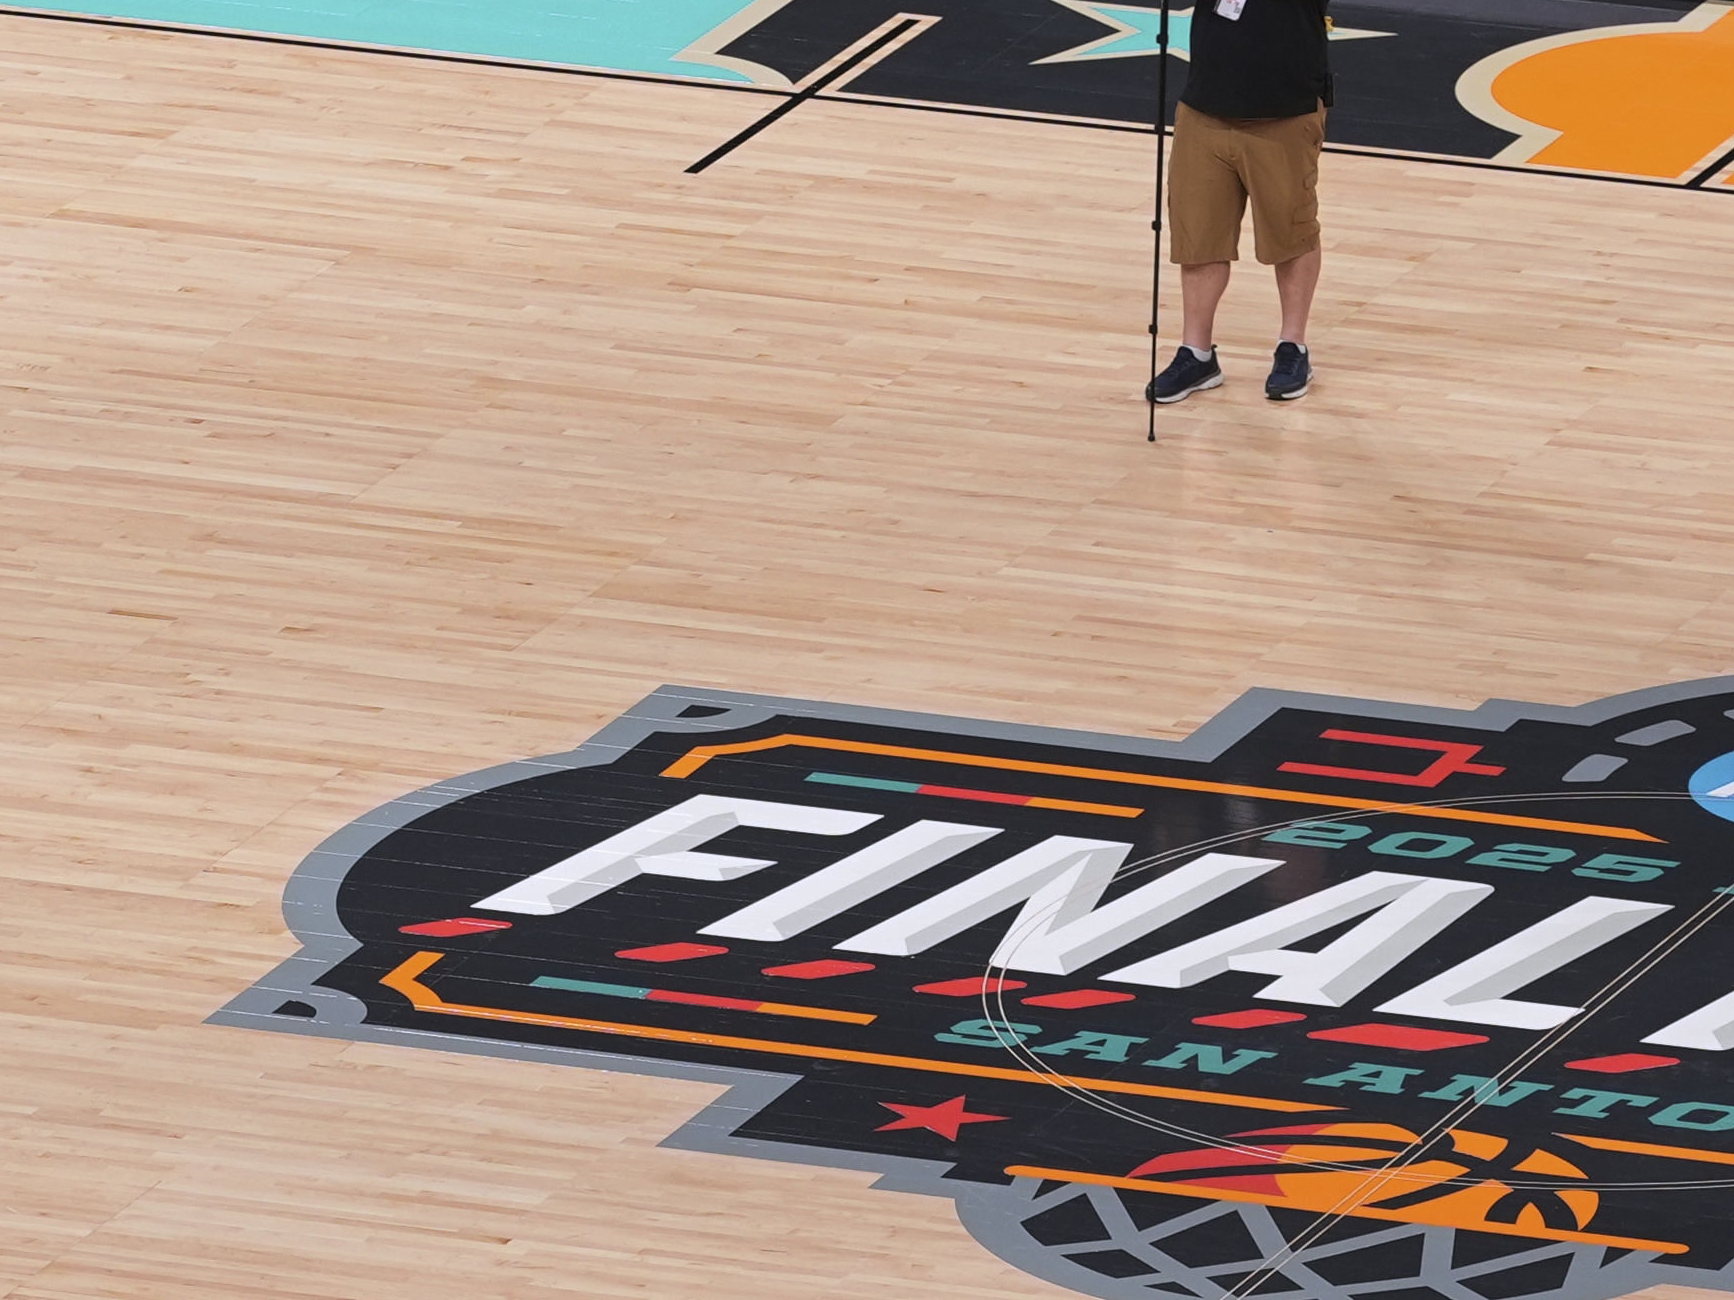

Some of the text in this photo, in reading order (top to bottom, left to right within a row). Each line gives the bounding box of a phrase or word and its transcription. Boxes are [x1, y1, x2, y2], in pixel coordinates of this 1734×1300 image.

[1267, 823, 1677, 881] 2025
[471, 794, 1675, 1031] FINAL
[936, 1020, 1275, 1074] SAN
